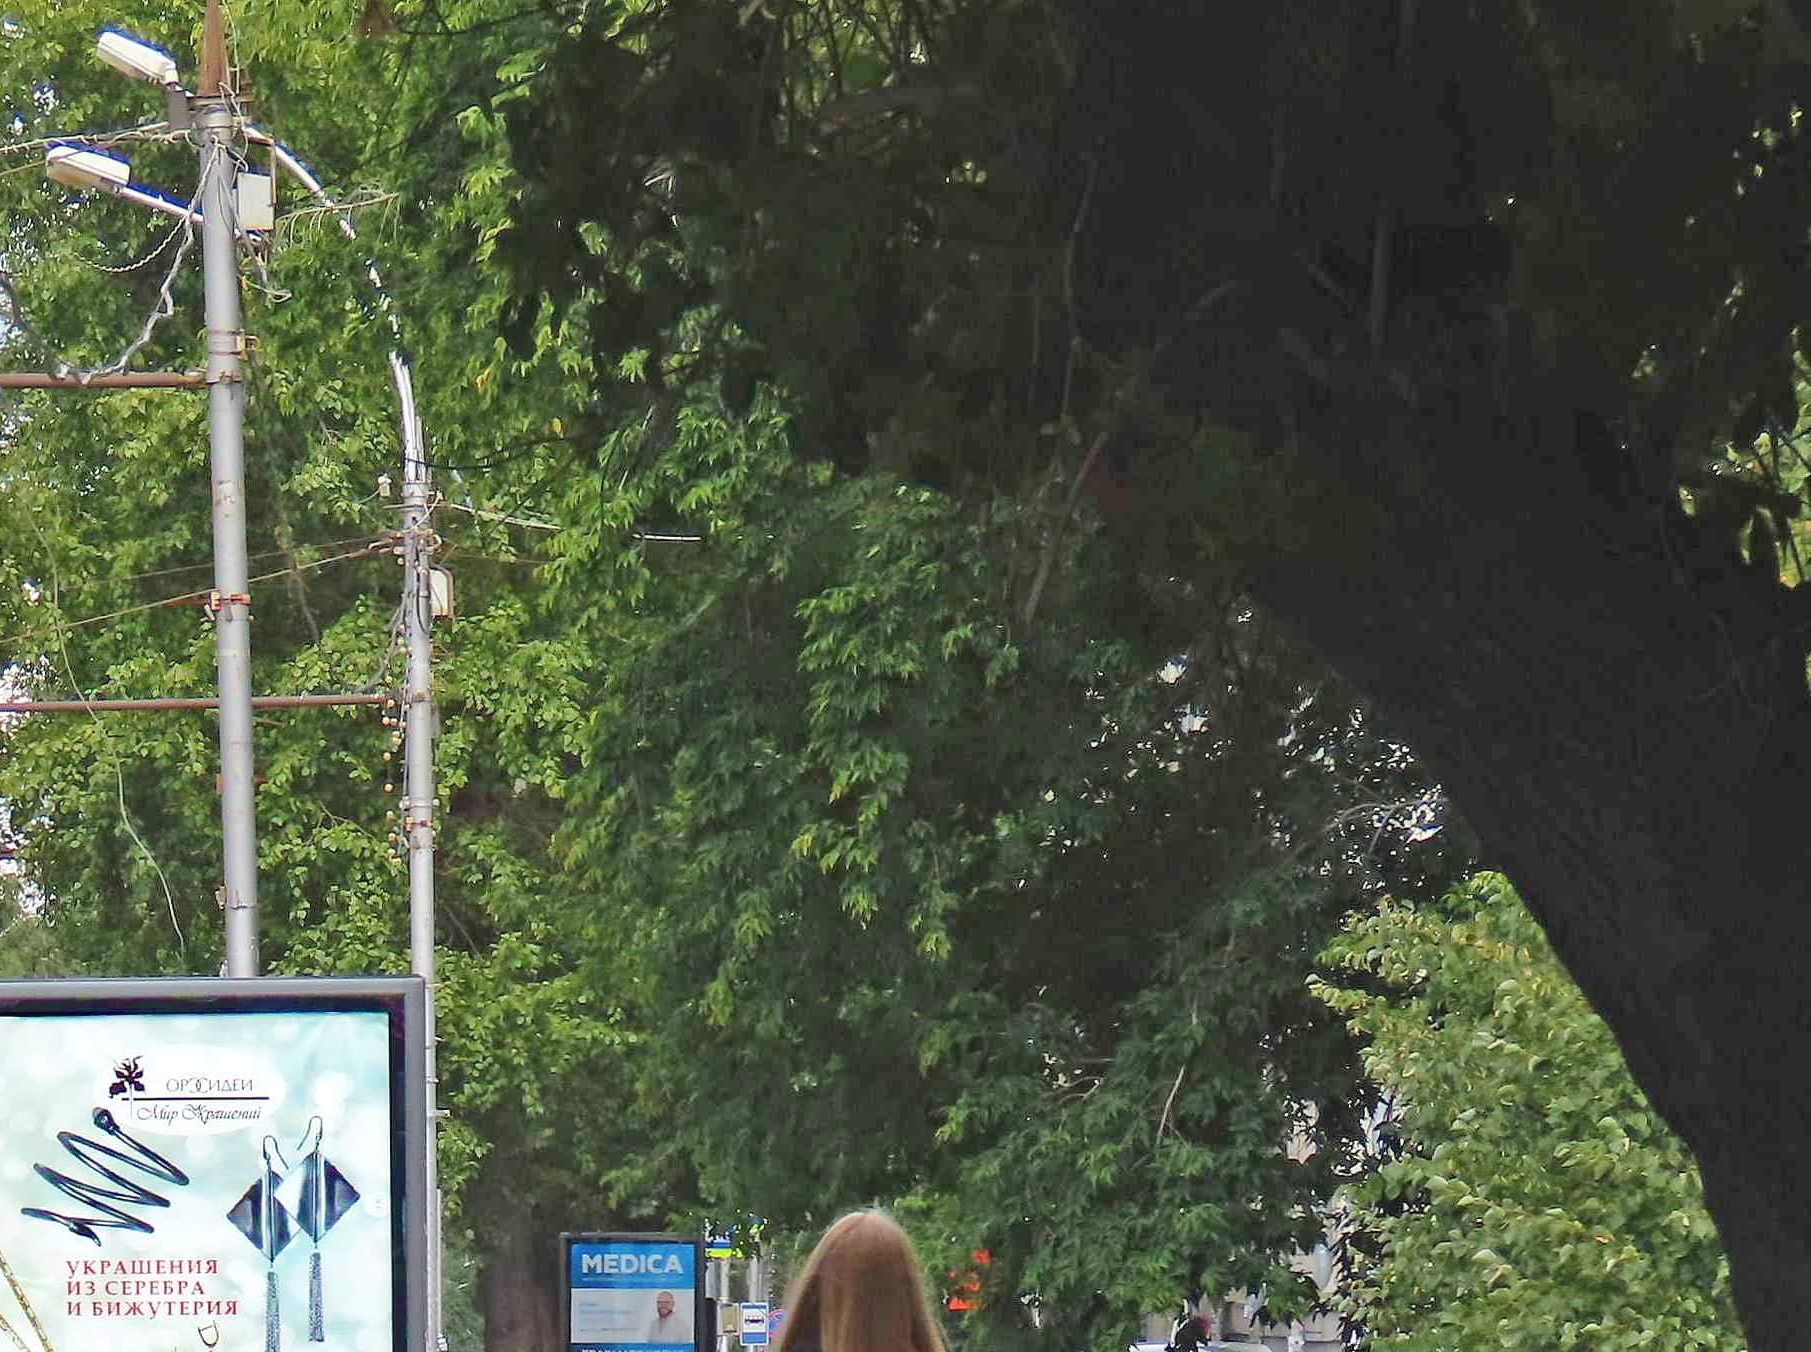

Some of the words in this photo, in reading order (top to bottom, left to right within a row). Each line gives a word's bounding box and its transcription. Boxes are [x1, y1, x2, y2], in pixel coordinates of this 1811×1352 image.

[66, 1259, 219, 1279] УКРАШЕНИЯ
[582, 1254, 684, 1274] MEDICA
[67, 1280, 96, 1296] ИЗ
[105, 1280, 205, 1296] СЕРЕБРА
[67, 1301, 81, 1316] И
[92, 1300, 238, 1320] БИЖУТЕРИЯ
